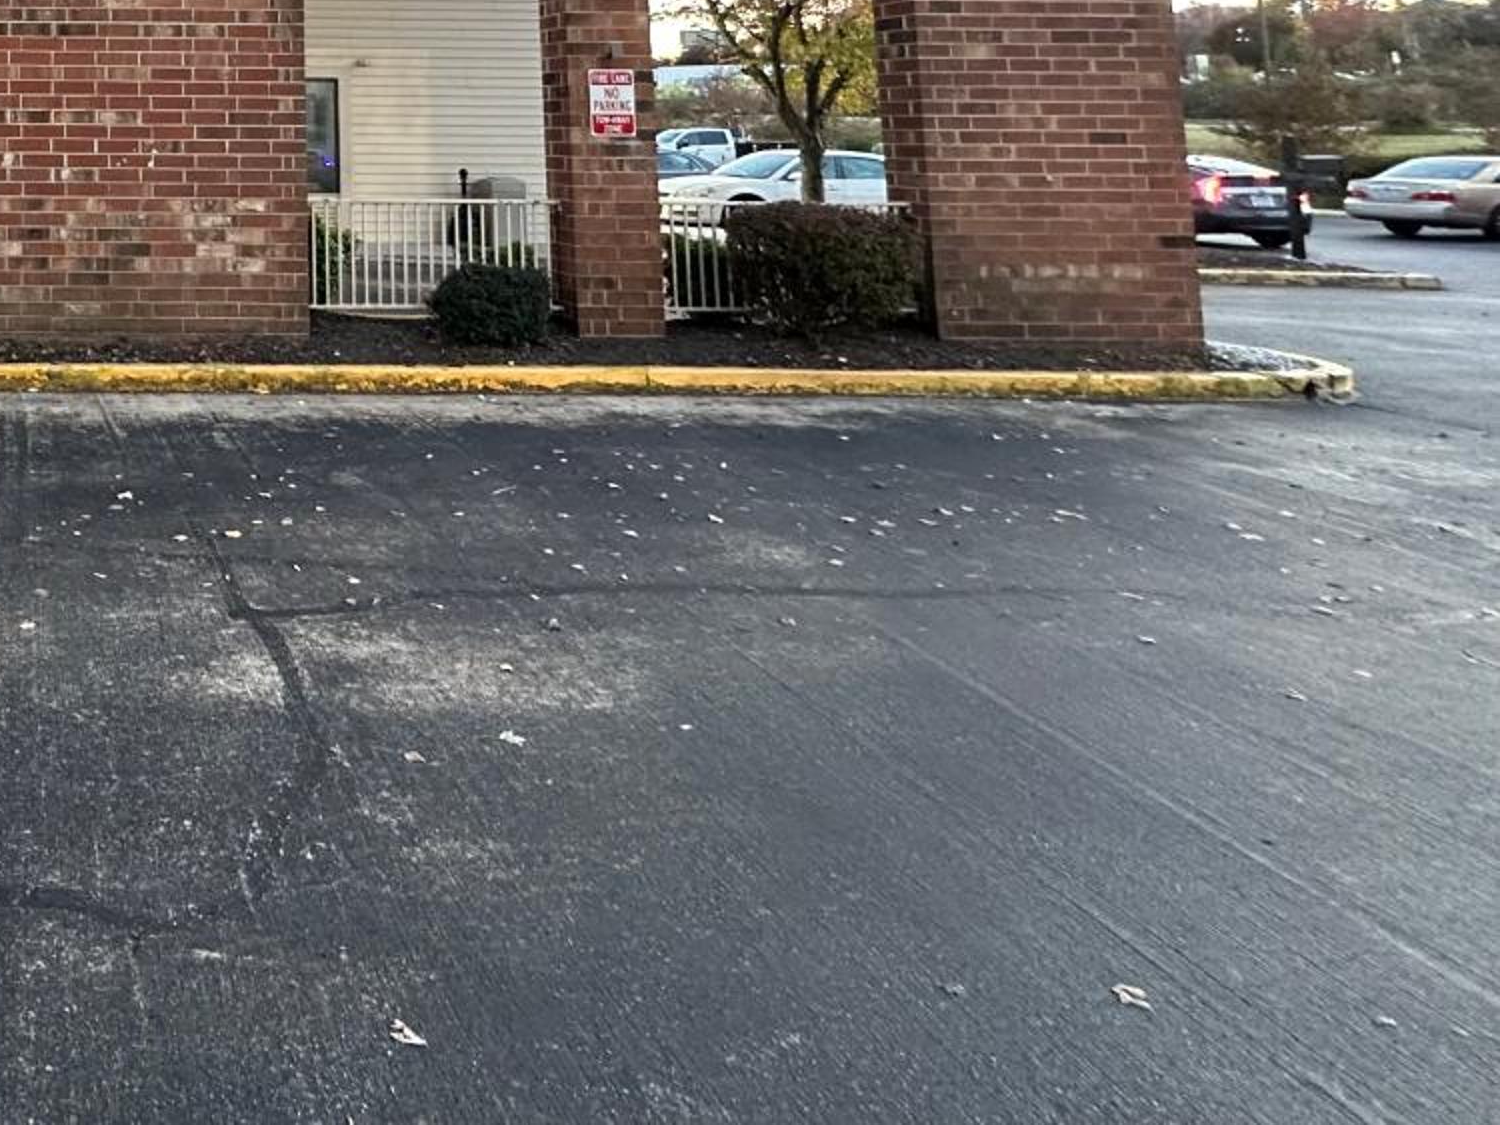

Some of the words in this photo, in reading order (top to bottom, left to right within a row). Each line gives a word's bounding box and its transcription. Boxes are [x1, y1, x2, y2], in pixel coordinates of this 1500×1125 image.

[611, 74, 630, 84] LANE
[603, 87, 620, 99] NO
[593, 100, 632, 111] PARKING
